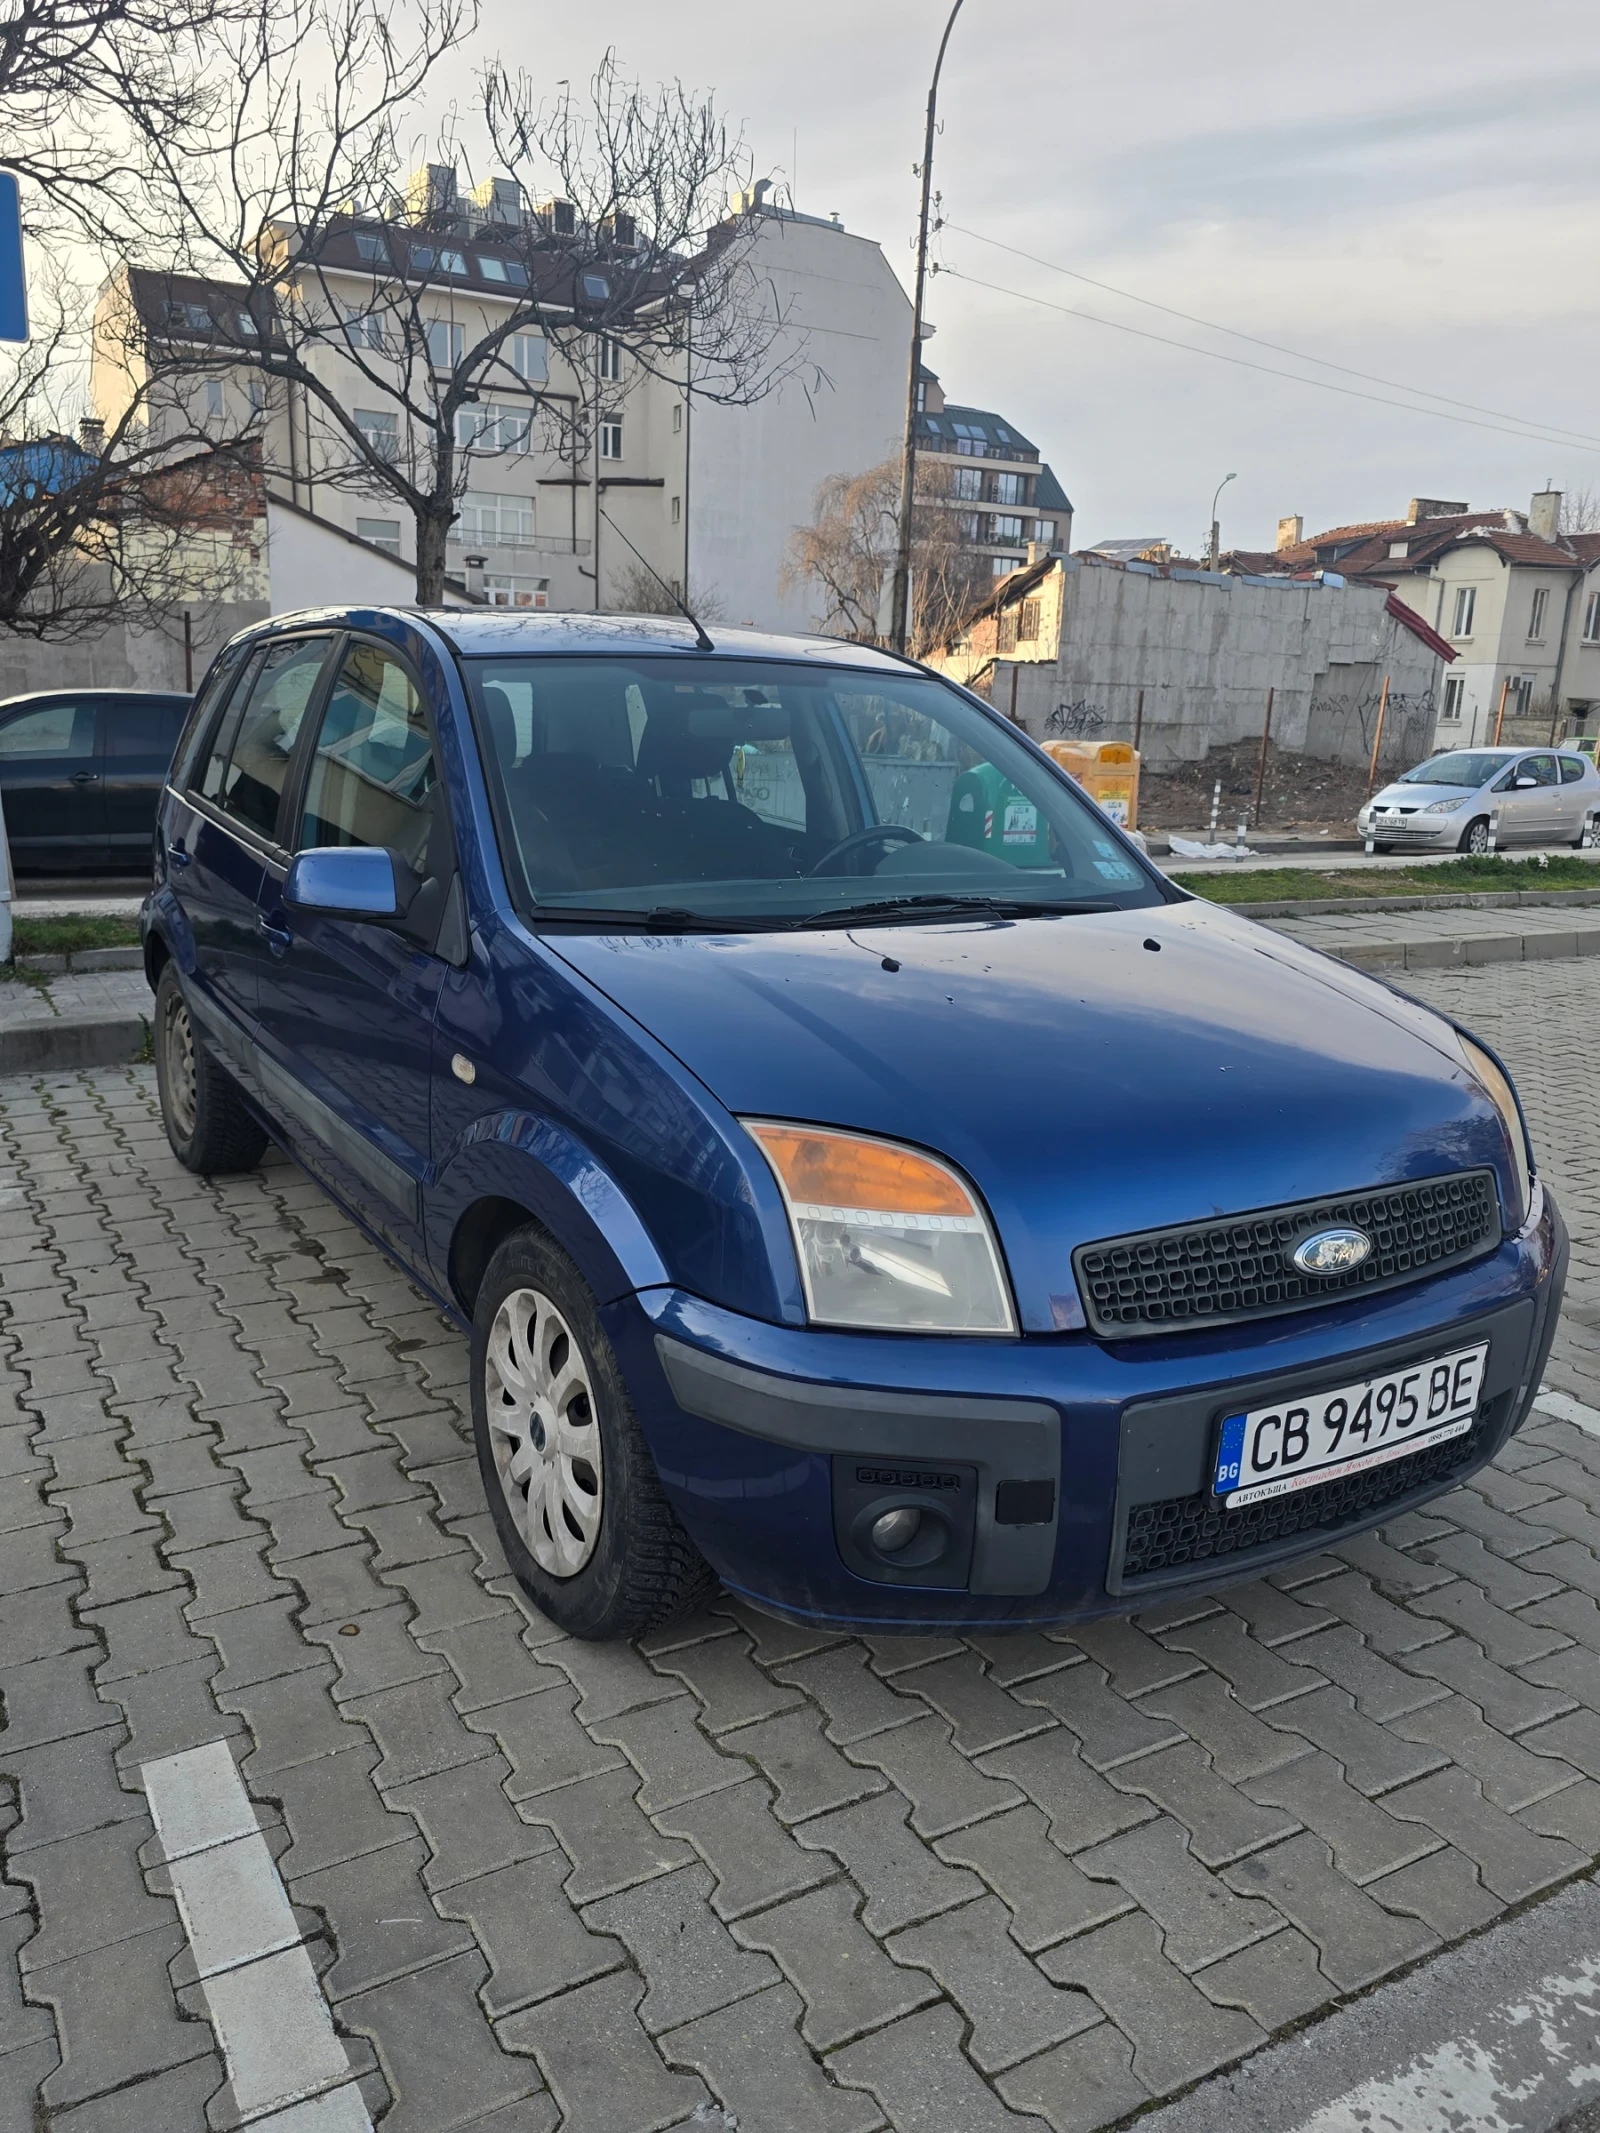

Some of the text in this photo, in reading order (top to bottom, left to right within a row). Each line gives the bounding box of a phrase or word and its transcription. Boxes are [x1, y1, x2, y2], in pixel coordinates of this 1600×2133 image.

[1251, 1355, 1478, 1473] CB 9495 BE
[1217, 1462, 1239, 1483] BG
[1236, 1484, 1287, 1504] АВТОКЪЩА
[1290, 1466, 1343, 1489] Костадин
